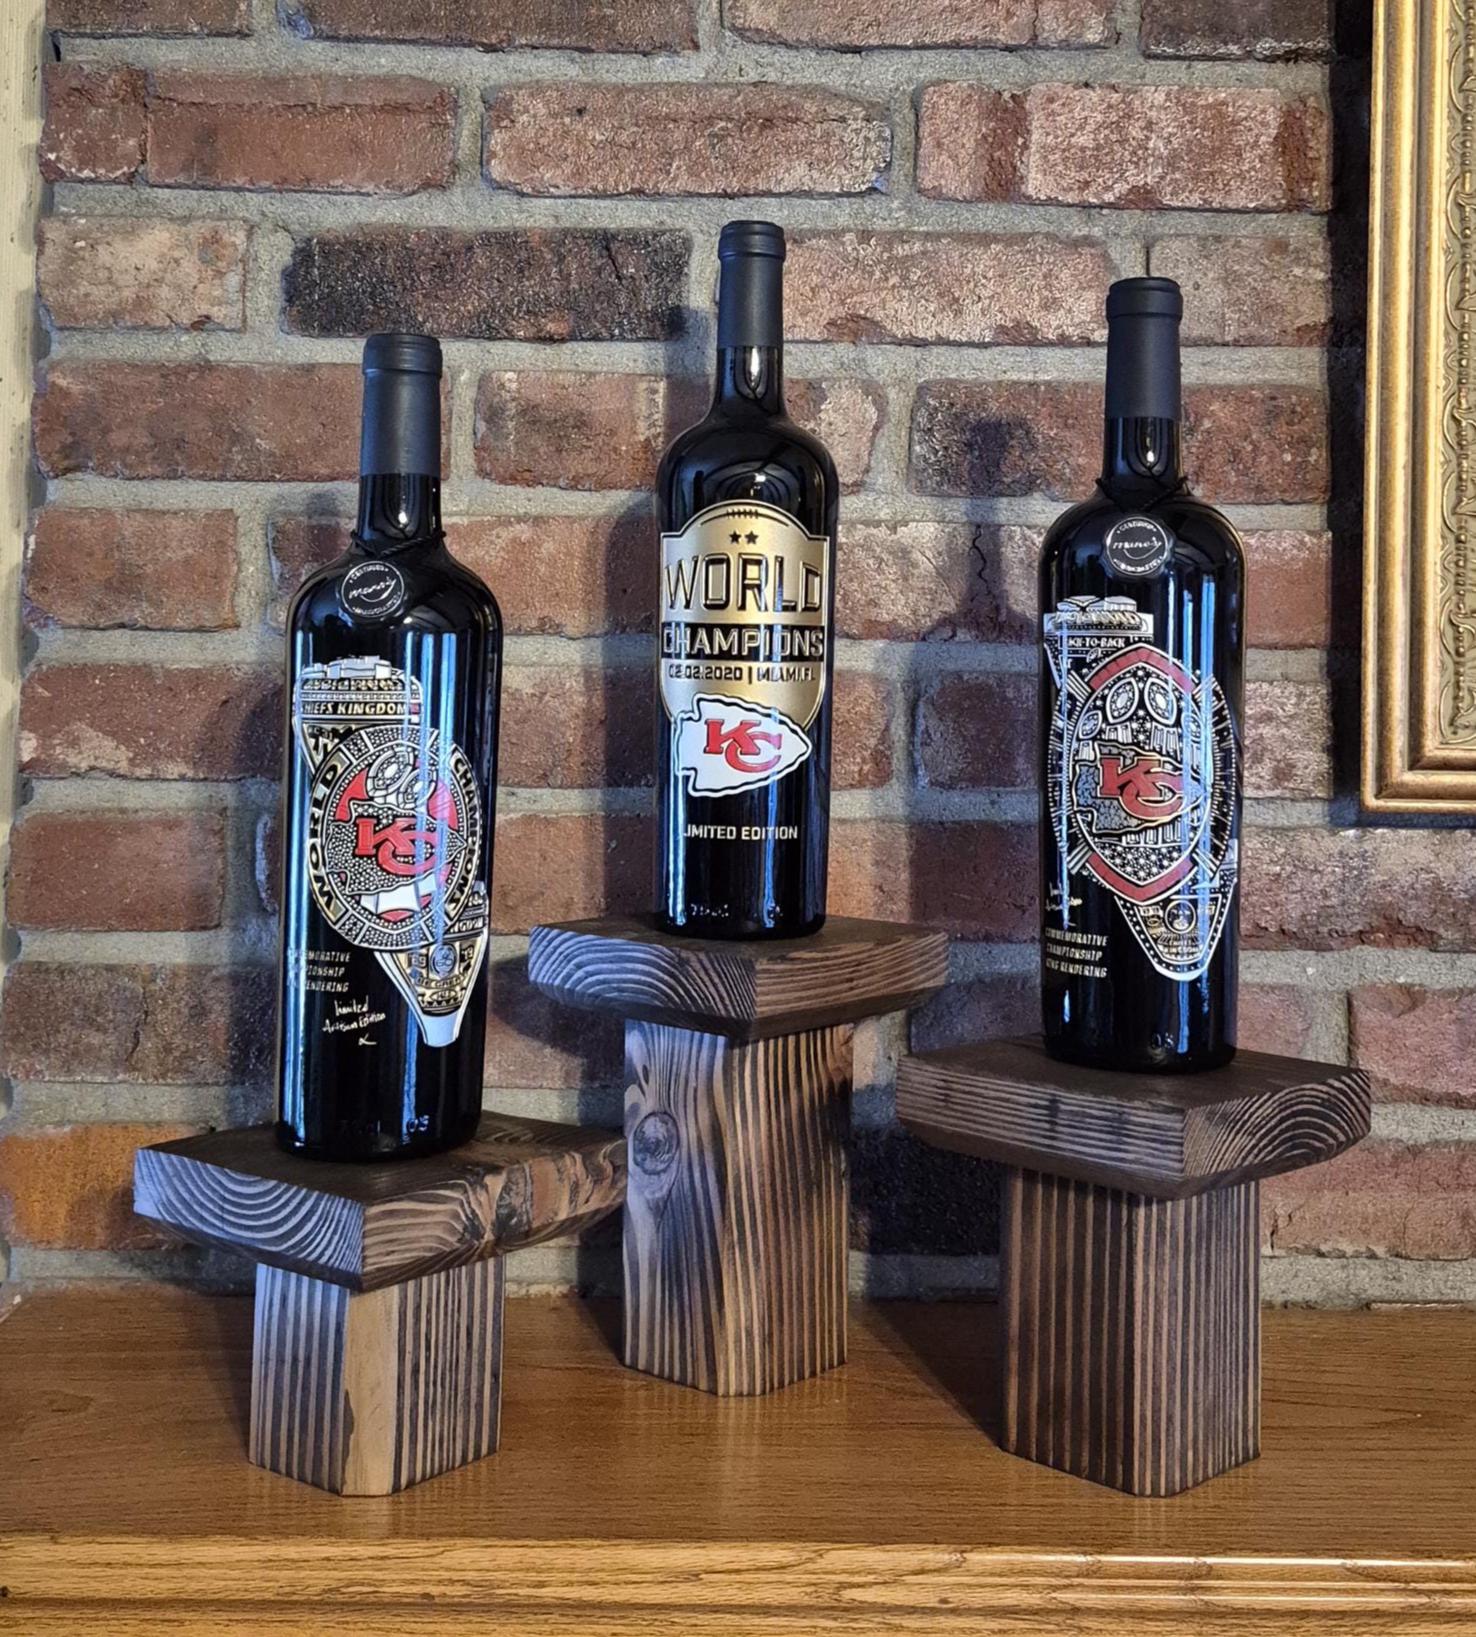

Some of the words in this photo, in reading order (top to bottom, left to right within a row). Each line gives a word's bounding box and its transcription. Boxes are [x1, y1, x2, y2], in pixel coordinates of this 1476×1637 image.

[665, 552, 822, 613] WORLD
[663, 627, 824, 656] CHAMPIONS
[669, 664, 743, 681] 02.02.2020
[301, 702, 334, 714] HIEFS
[703, 719, 782, 773] KC
[1098, 756, 1185, 820] KC
[308, 763, 339, 911] WORLD
[355, 818, 446, 876] KC
[741, 826, 798, 840] EDITION
